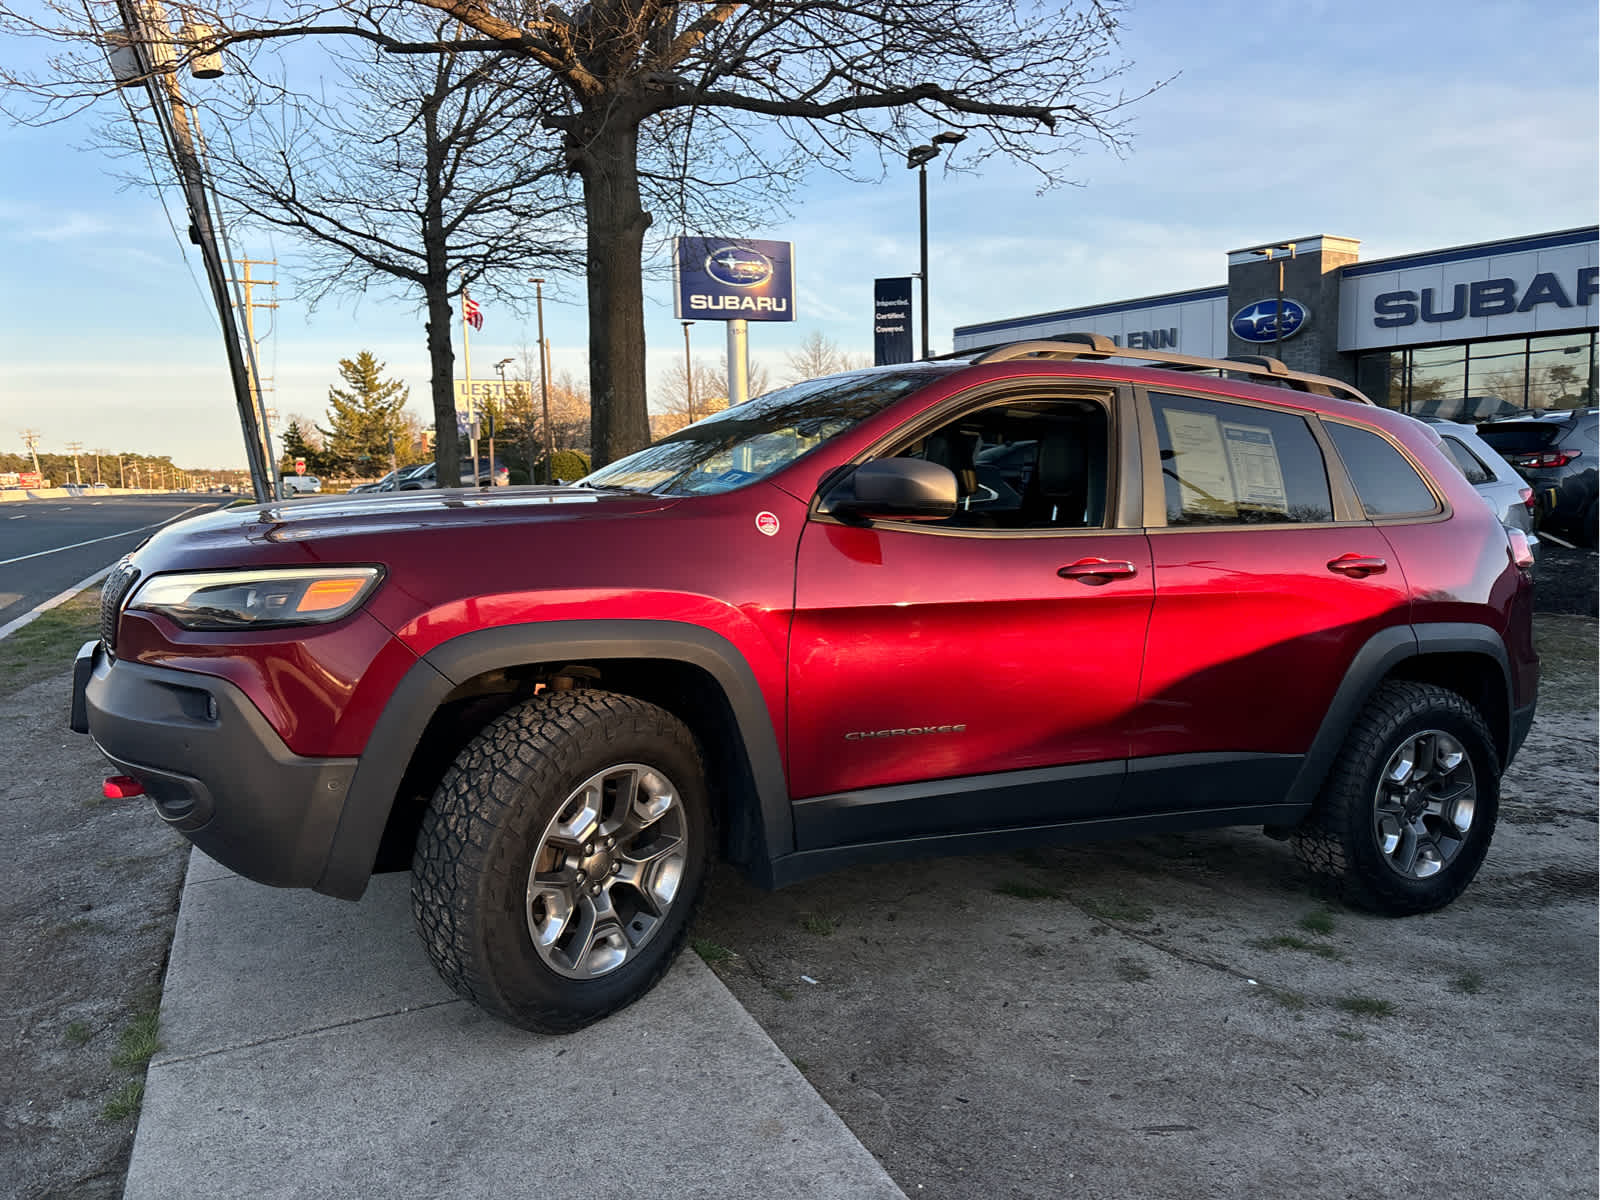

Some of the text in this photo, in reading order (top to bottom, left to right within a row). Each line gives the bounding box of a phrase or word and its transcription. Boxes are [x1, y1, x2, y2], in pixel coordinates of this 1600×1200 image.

[690, 294, 786, 312] SUBARU
[1111, 327, 1177, 350] LENN
[845, 724, 966, 740] CHEROKEE
